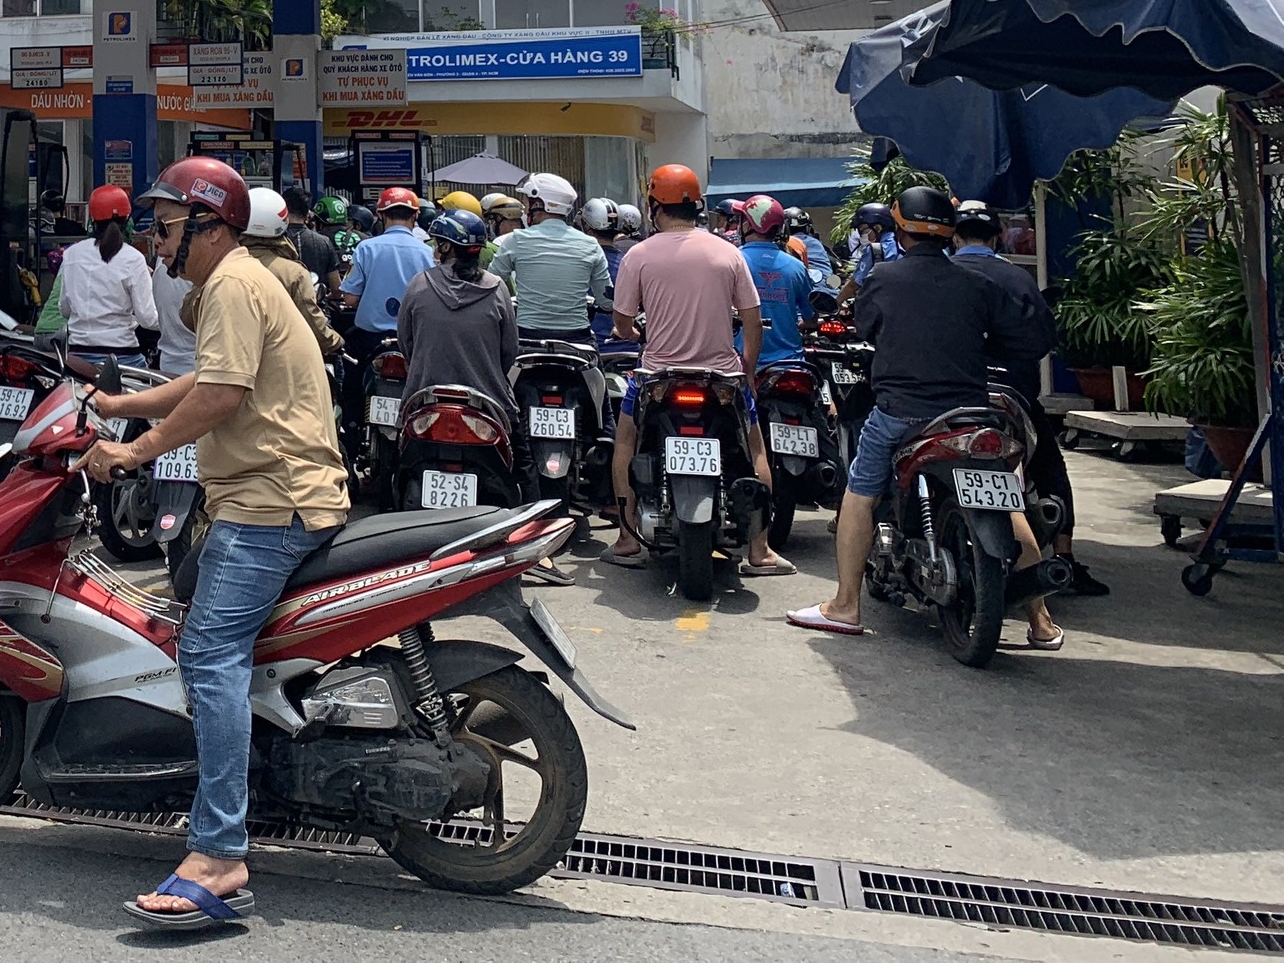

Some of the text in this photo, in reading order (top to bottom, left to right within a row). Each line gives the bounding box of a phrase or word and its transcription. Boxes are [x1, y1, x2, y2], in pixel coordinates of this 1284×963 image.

[209, 47, 223, 55] RON
[331, 52, 394, 64] KHU VỰC DÀNH CHO
[407, 48, 628, 67] TROLIMEX-CỬA HÀNG 39
[251, 56, 264, 64] CHO
[259, 66, 272, 74] ÔTÔ
[323, 62, 403, 74] QUÝ KHÁCH HÀNG XE ÔTÔ
[26, 79, 48, 87] 24180
[248, 79, 259, 89] VỤ
[337, 76, 389, 88] TỰ PHỤC VỤ
[31, 90, 84, 108] DẦU NHỜN
[157, 93, 182, 110] NƯỚC
[197, 89, 274, 103] KHI MUA XĂNG DẦU
[323, 89, 404, 101] KHI MUA XĂNG DẦU
[346, 110, 423, 127] DHL
[0, 389, 26, 404] 59-C1
[536, 408, 569, 423] 59-C3
[533, 422, 572, 437] 260.54
[777, 426, 809, 442] 59-L1
[674, 440, 712, 456] 59-C3
[774, 438, 815, 455] 642.38
[669, 456, 717, 473] 073.76
[431, 473, 469, 491] 52-S4
[964, 472, 1009, 490] 59-C1
[430, 492, 468, 507] 8226
[962, 489, 1020, 508] 543.20
